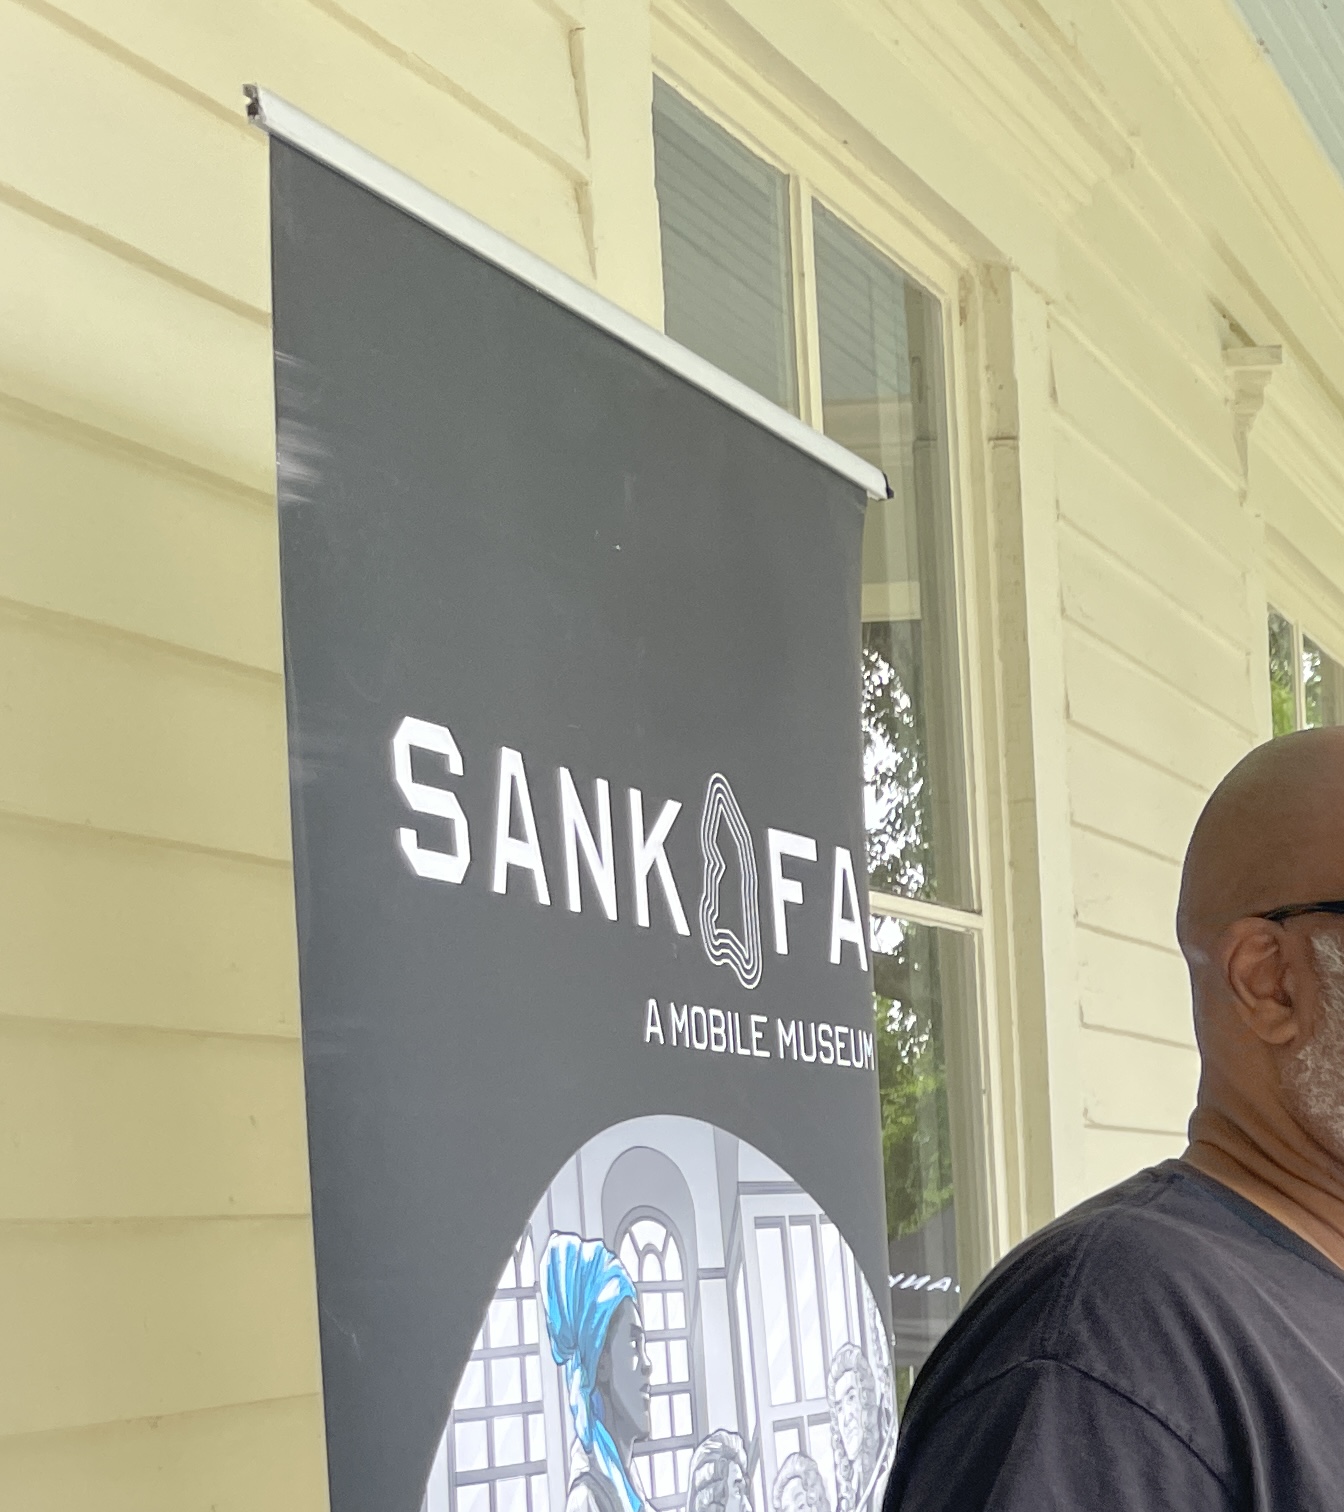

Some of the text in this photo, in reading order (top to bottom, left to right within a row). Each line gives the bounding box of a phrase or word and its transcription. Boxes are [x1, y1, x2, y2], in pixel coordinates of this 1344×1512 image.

[644, 998, 876, 1071] A MOBILE MUSEUM
